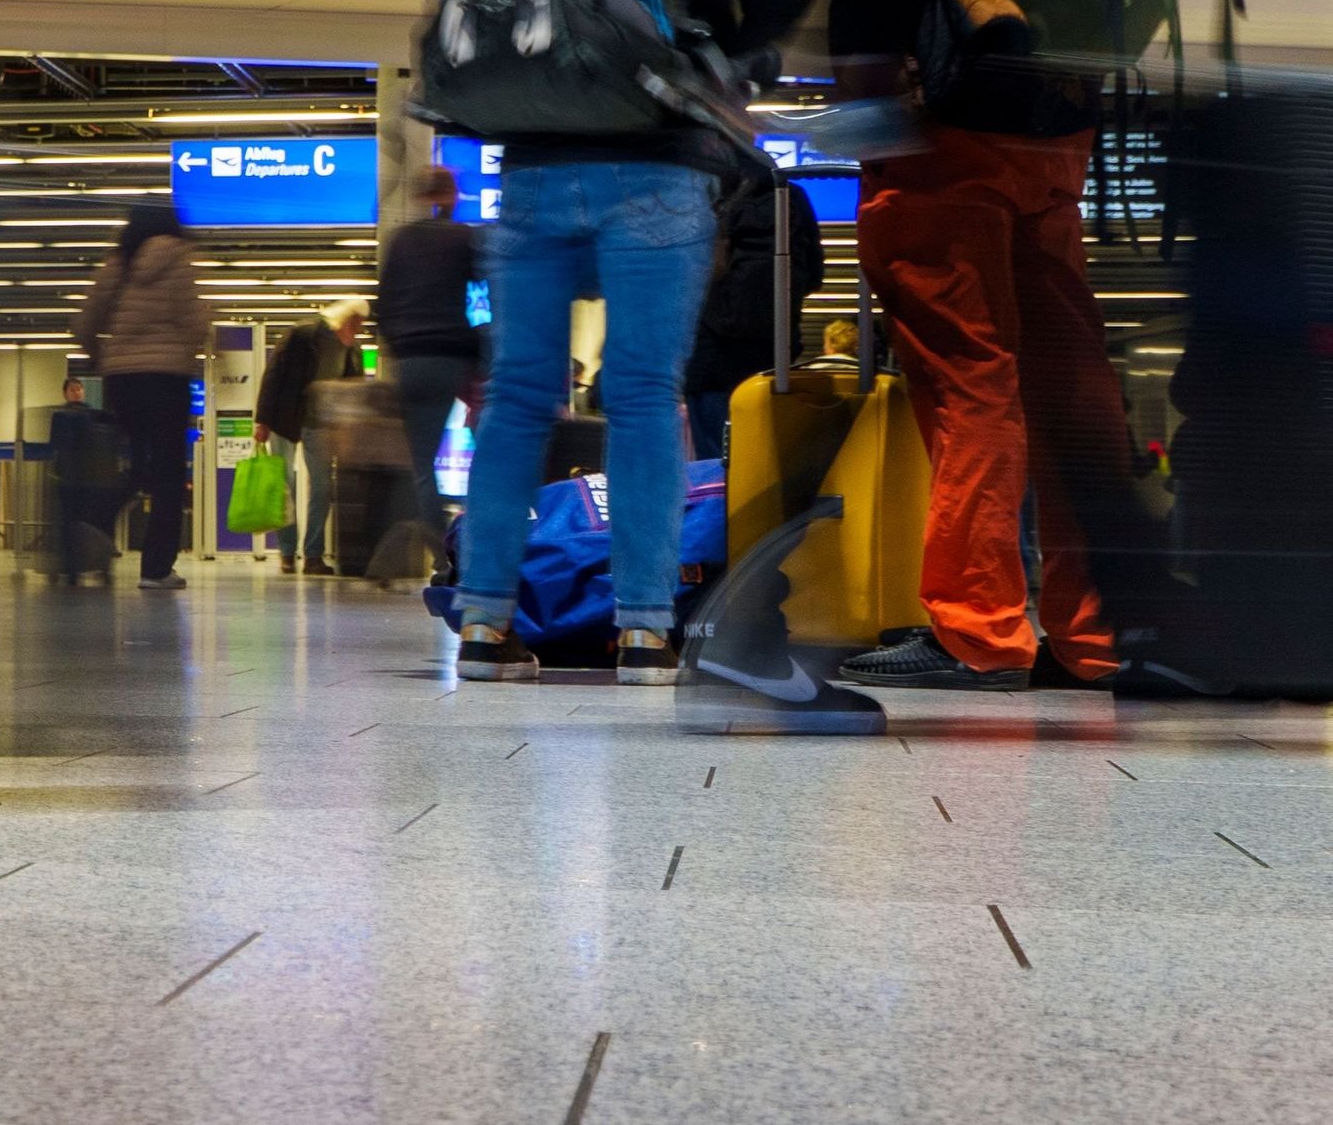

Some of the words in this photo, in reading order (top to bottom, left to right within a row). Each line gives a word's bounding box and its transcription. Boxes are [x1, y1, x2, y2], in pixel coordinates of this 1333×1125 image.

[245, 147, 286, 163] Abflug
[313, 144, 336, 177] C
[245, 163, 311, 178] Departures
[684, 623, 715, 638] NIKE
